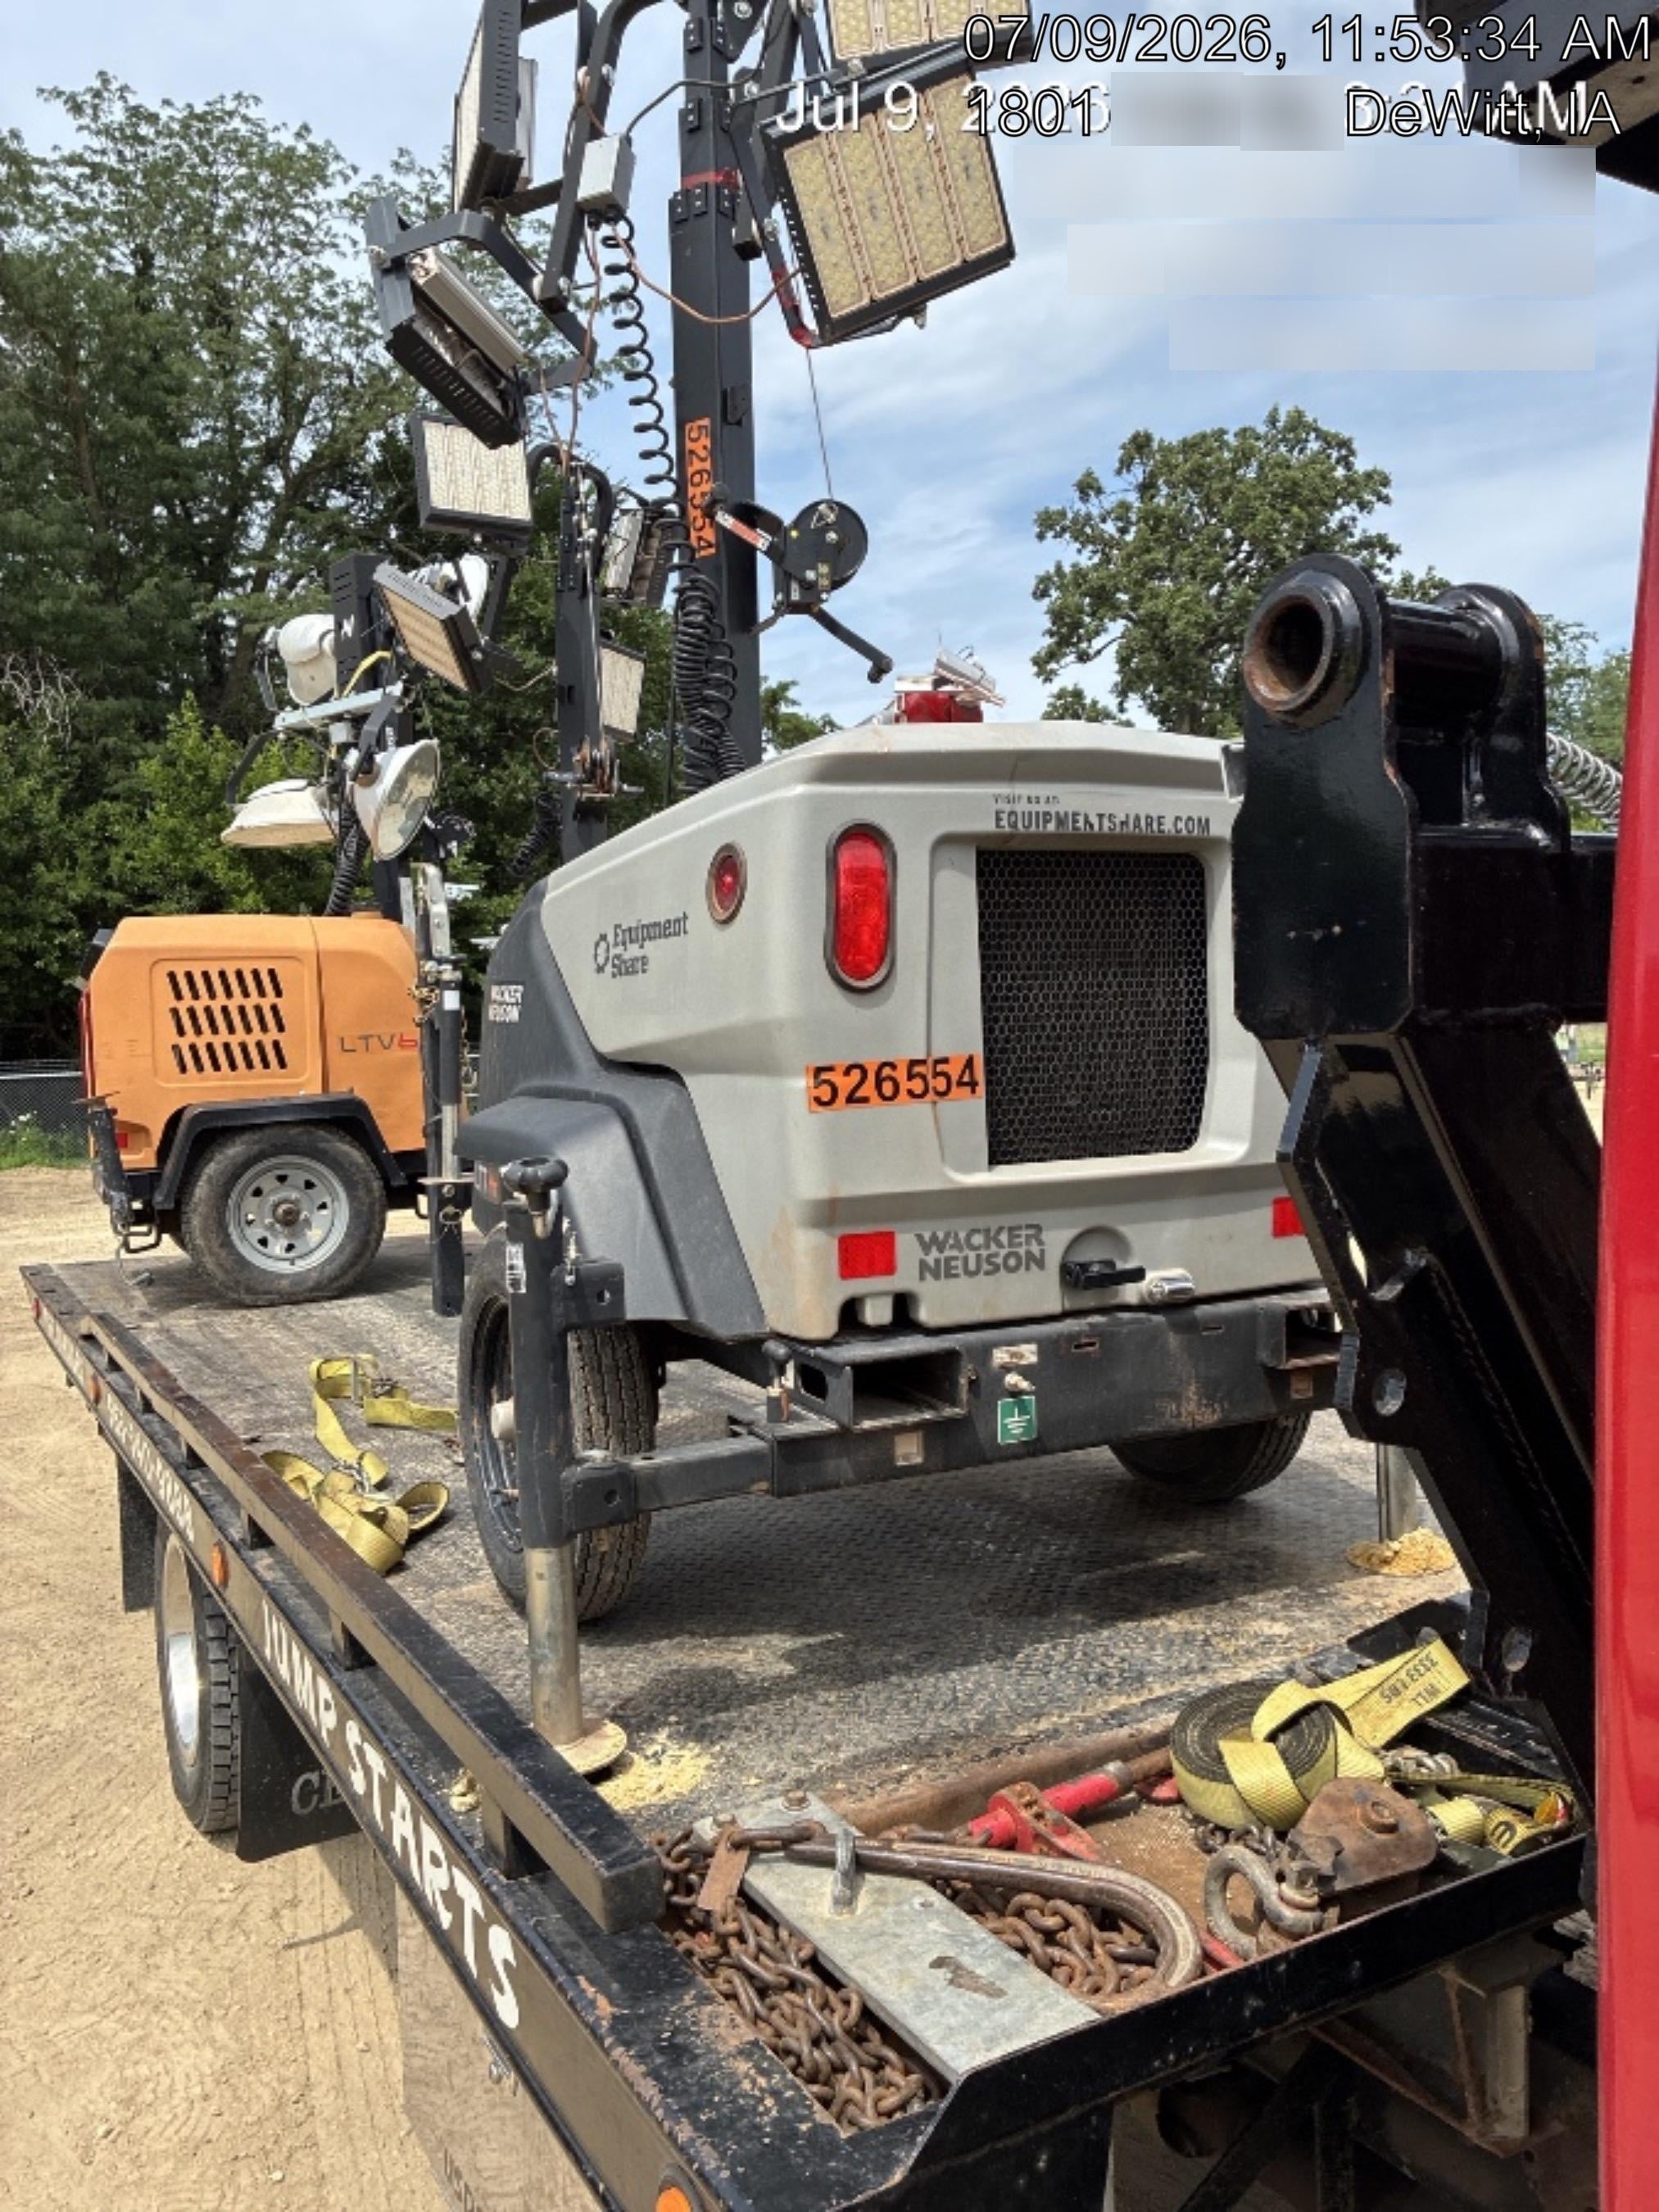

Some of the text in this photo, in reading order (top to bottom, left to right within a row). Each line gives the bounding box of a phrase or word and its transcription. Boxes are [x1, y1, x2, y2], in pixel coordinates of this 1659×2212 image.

[687, 423, 715, 548] 526554
[995, 809, 1211, 836] EQUIPMENTSHARE.COM
[612, 911, 689, 952] Equipment
[611, 953, 649, 979] Share
[813, 1054, 979, 1108] 526554
[913, 1223, 1045, 1257] WACKER
[918, 1248, 1046, 1282] NEUSON
[261, 1600, 519, 2029] JUMP STARTS
